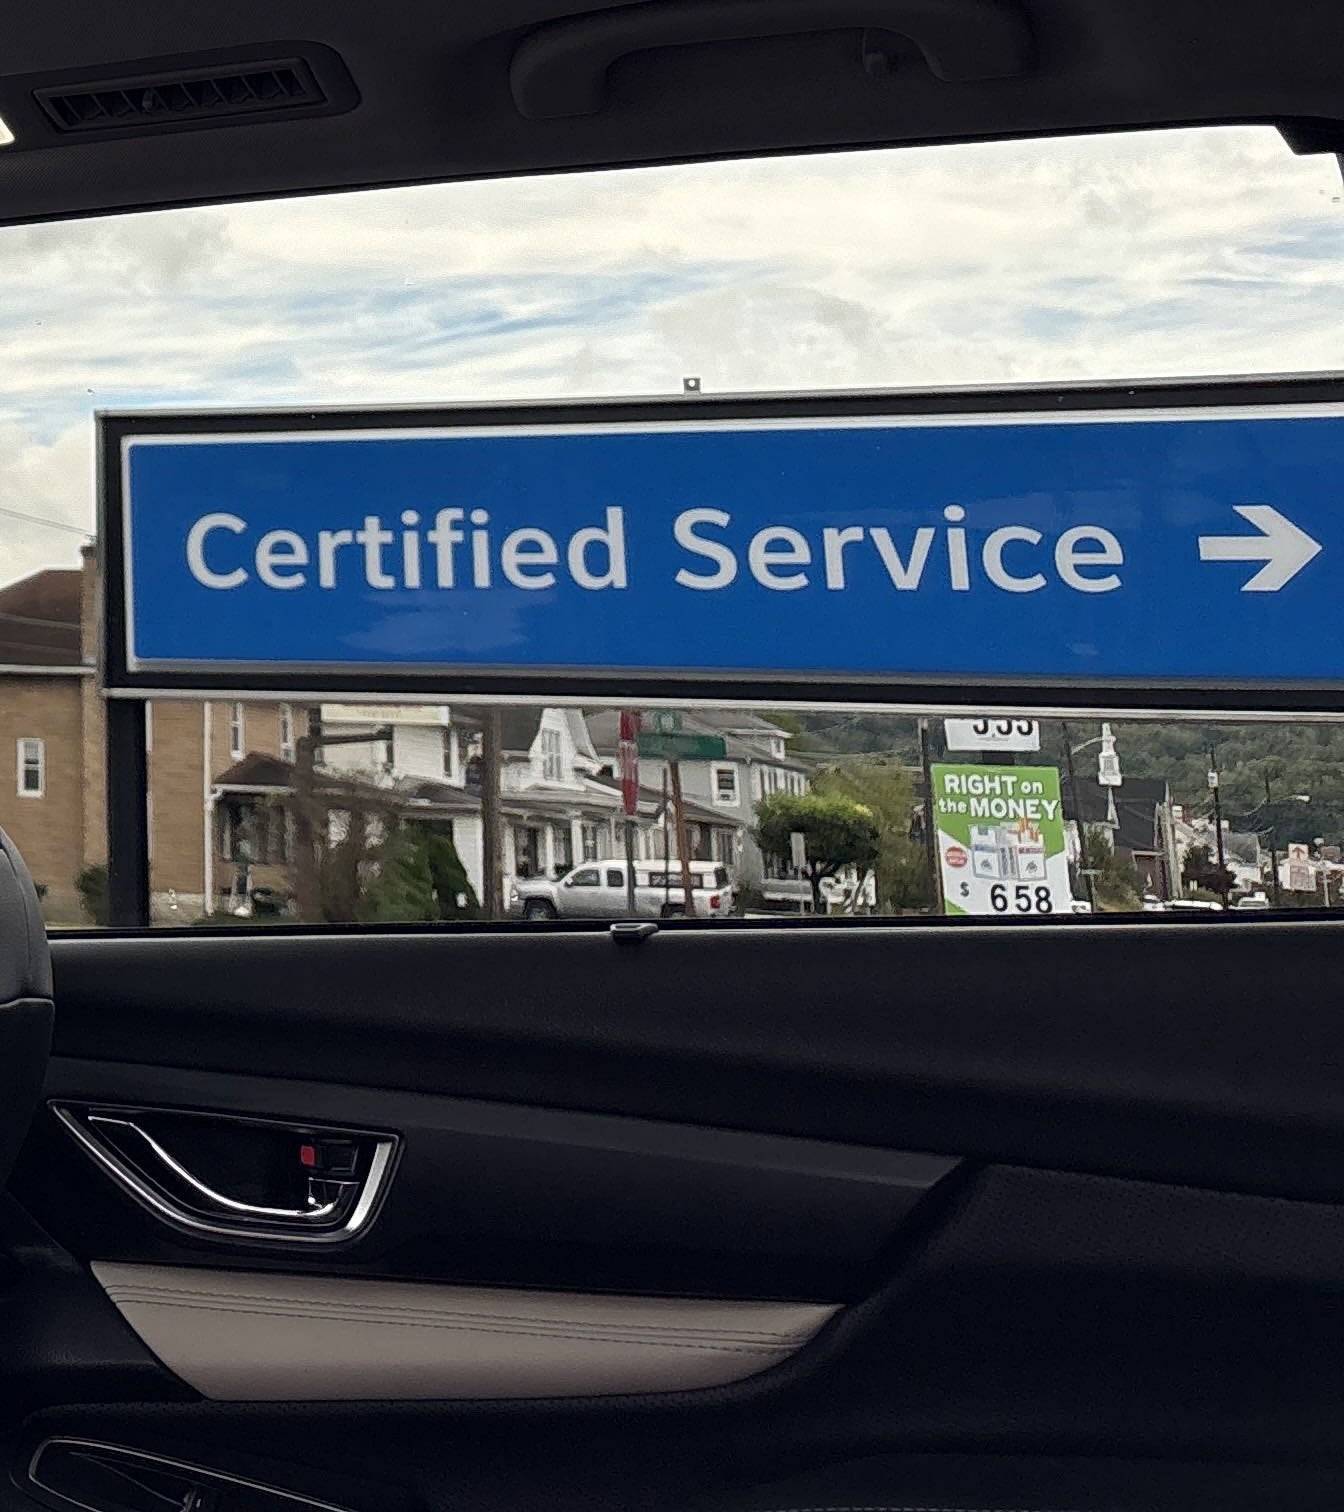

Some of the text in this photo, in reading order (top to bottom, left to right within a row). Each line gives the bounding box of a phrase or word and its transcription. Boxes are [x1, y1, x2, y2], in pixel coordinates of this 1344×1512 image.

[186, 504, 1124, 592] Certified Service
[944, 774, 1043, 795] RIGHT on
[938, 797, 1059, 821] the MONEY
